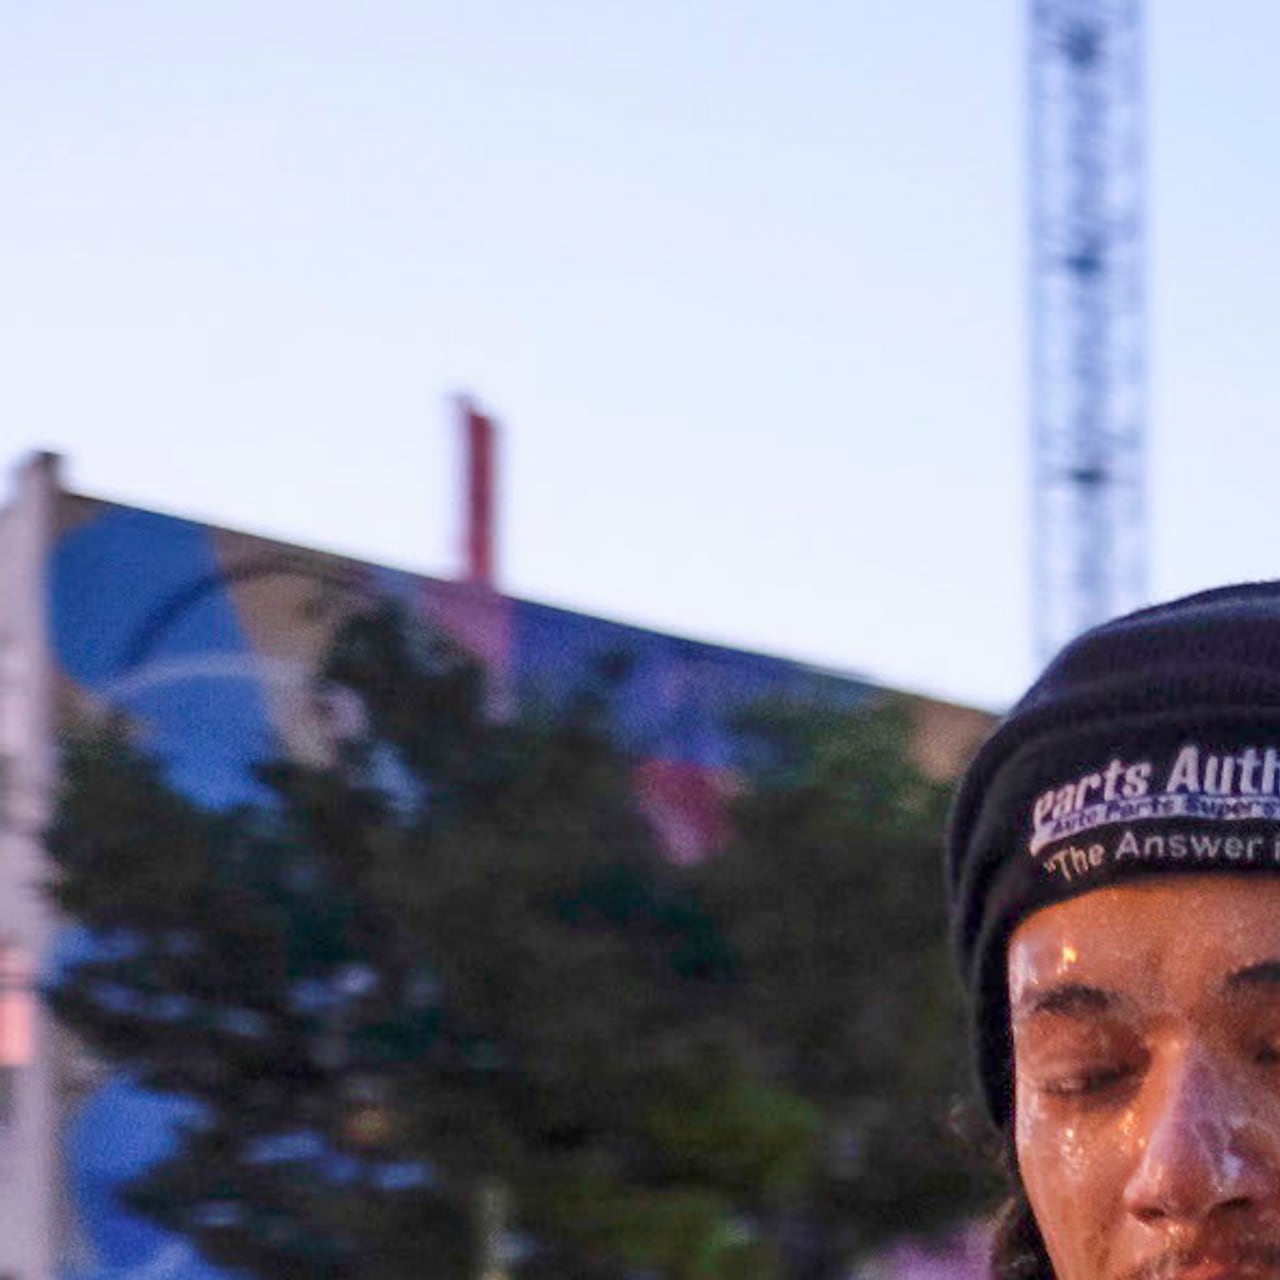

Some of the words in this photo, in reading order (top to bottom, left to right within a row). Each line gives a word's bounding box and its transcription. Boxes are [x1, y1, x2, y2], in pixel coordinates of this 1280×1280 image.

[1029, 757, 1151, 840] Parts
[1043, 843, 1105, 882] "The
[1114, 831, 1265, 861] Answer
